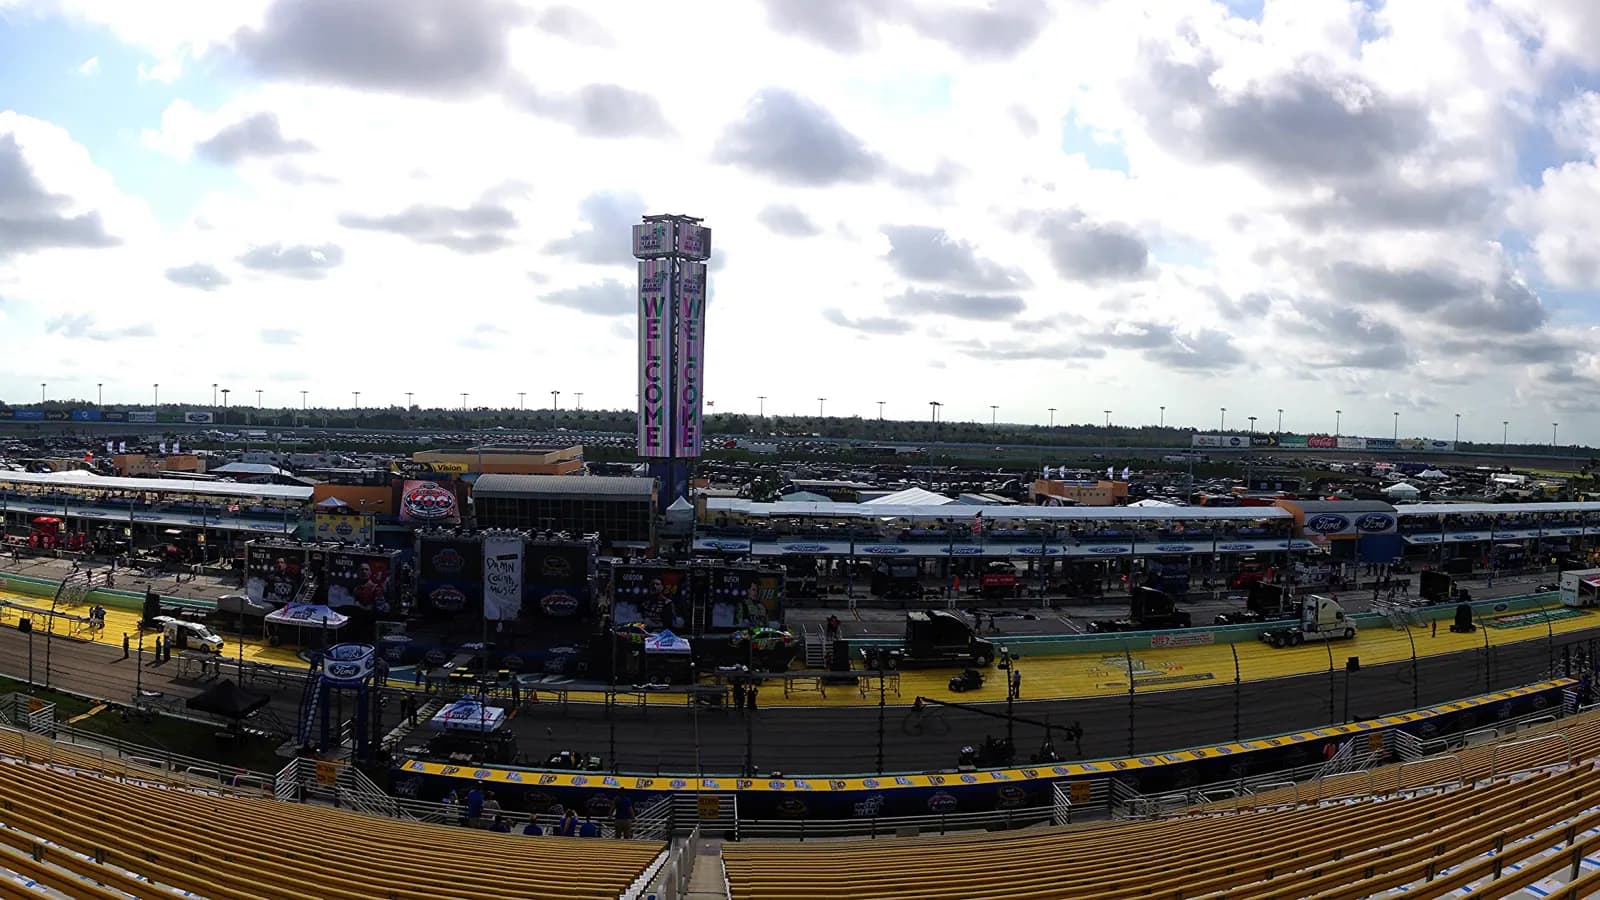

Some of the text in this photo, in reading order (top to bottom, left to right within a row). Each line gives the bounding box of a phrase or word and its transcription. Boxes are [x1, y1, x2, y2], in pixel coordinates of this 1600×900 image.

[642, 297, 665, 447] WELCOME
[682, 297, 702, 448] WELCOME
[437, 464, 462, 472] Vision
[1316, 516, 1342, 530] Ford
[1362, 515, 1387, 528] Ford
[487, 557, 514, 573] DAMN
[333, 664, 355, 677] Ford
